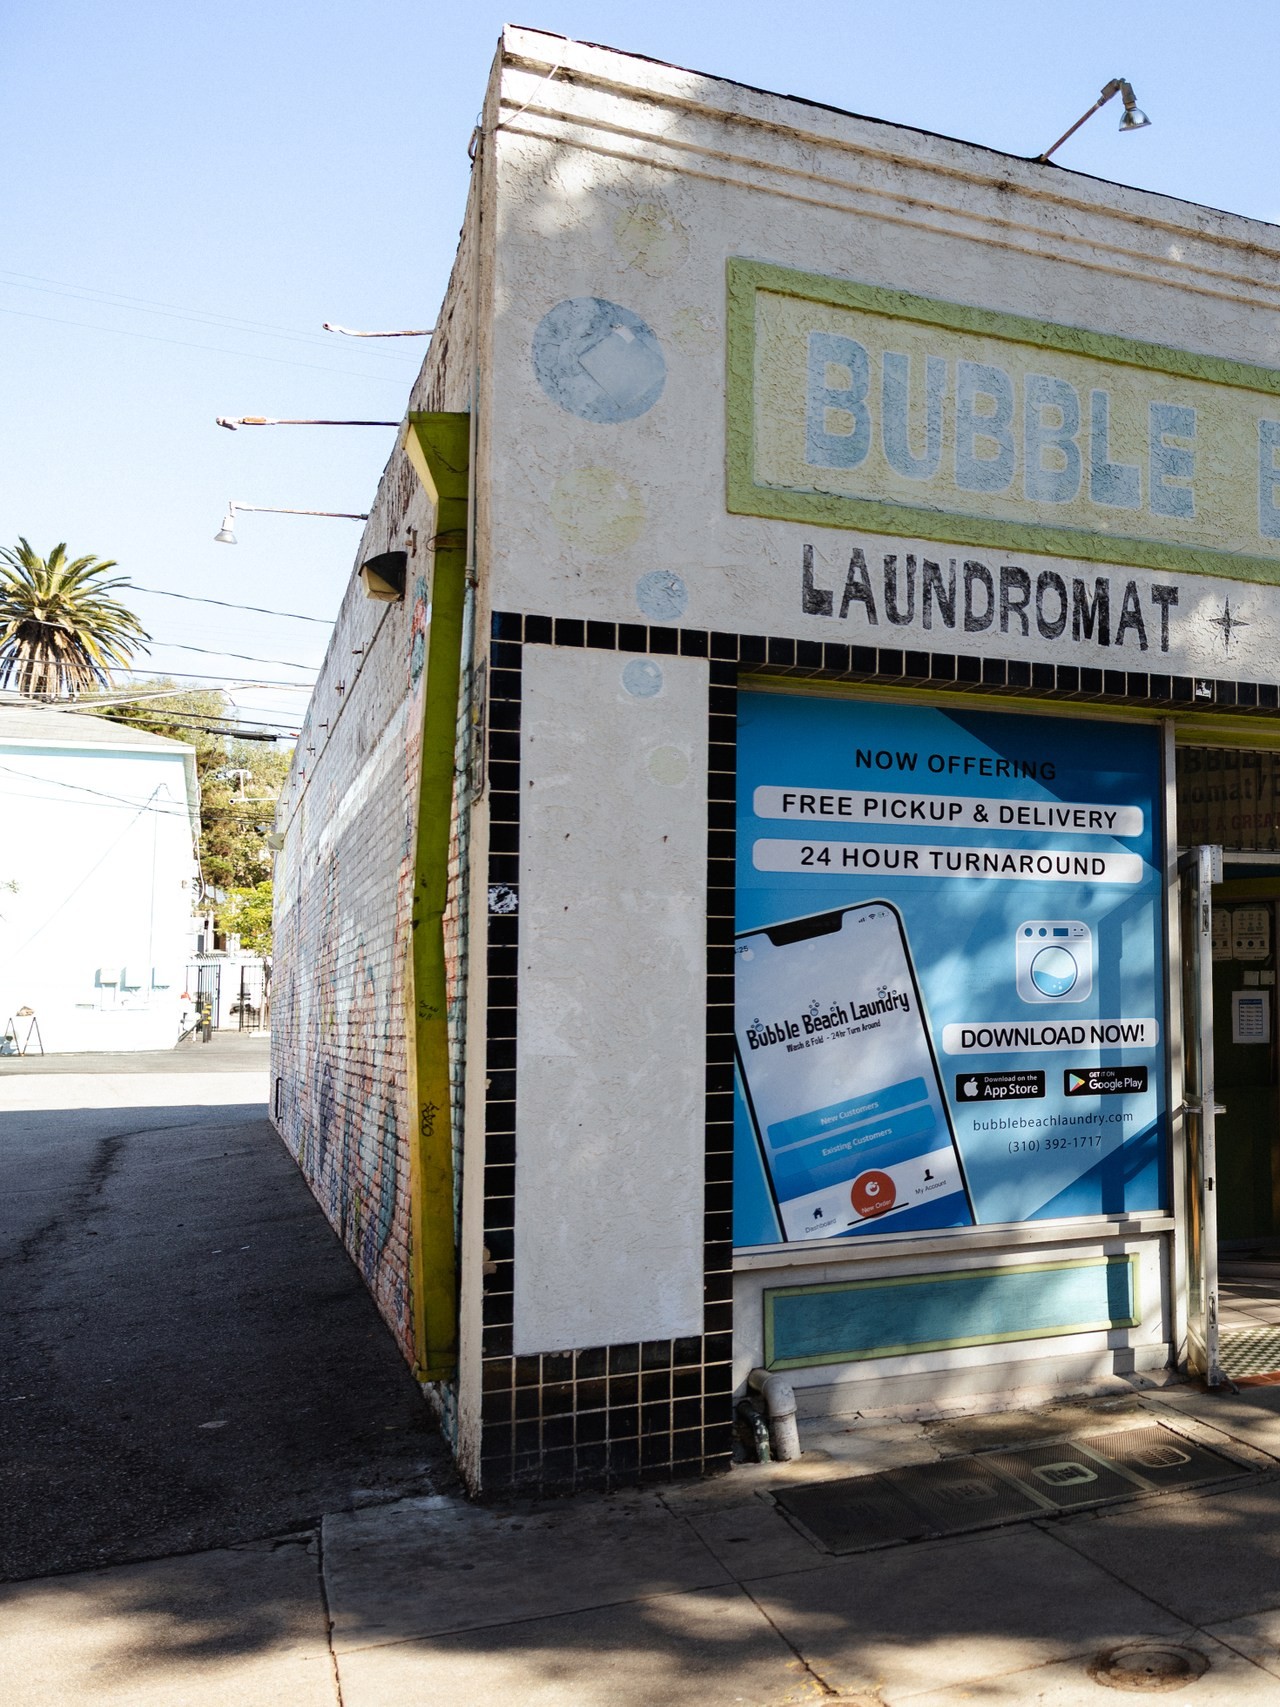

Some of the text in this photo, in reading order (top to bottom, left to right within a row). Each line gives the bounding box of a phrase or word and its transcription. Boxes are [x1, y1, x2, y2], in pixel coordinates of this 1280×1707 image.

[805, 330, 1198, 519] BUBBLE
[801, 543, 1179, 653] LAUNDROMAT
[855, 749, 1057, 781] NOW OFFERING
[782, 793, 1118, 830] FREE PICKUP & DELIVERY
[800, 846, 1106, 876] 24 HOUR TURNAROUND
[746, 991, 911, 1050] Bubble Beach Laundry
[786, 1041, 805, 1053] Wash
[805, 1039, 811, 1047] &
[811, 1035, 825, 1046] Fold
[847, 1024, 861, 1036] Turn
[861, 1019, 882, 1032] Around
[961, 1023, 1145, 1049] DOWNLOAD NOW!
[984, 1075, 1016, 1083] Download
[984, 1083, 1038, 1098] App Store
[1089, 1077, 1143, 1091] Google Play
[820, 1101, 879, 1126] New Customers
[973, 1112, 1133, 1131] bubblebeachlaundry.com
[822, 1127, 893, 1157] Existing Customers
[1008, 1135, 1102, 1154] (310) 392-1717
[915, 1179, 947, 1195] My Account
[861, 1205, 875, 1214] New
[805, 1217, 837, 1233] Dashboard
